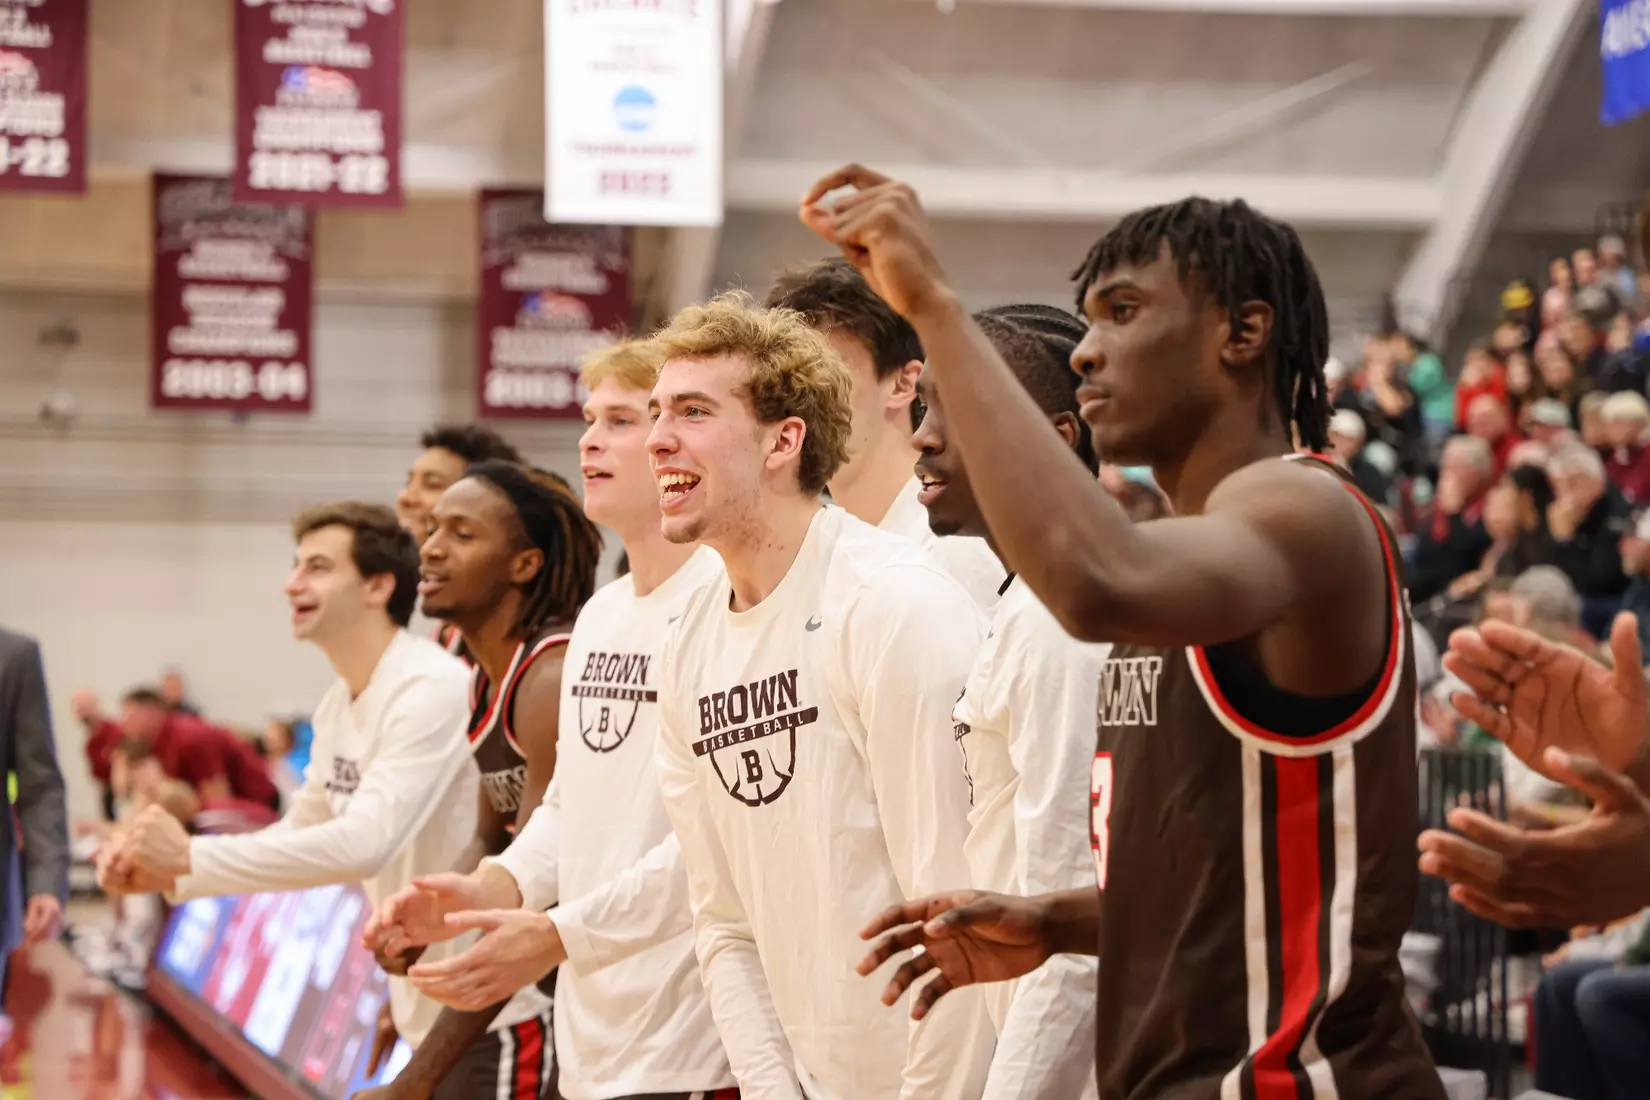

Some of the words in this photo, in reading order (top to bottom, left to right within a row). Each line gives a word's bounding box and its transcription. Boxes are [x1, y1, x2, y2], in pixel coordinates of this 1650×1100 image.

[580, 652, 651, 686] BROWN
[598, 706, 610, 733] B
[698, 669, 798, 736] BROWN
[702, 712, 804, 753] BASKETBALL
[741, 749, 763, 784] B
